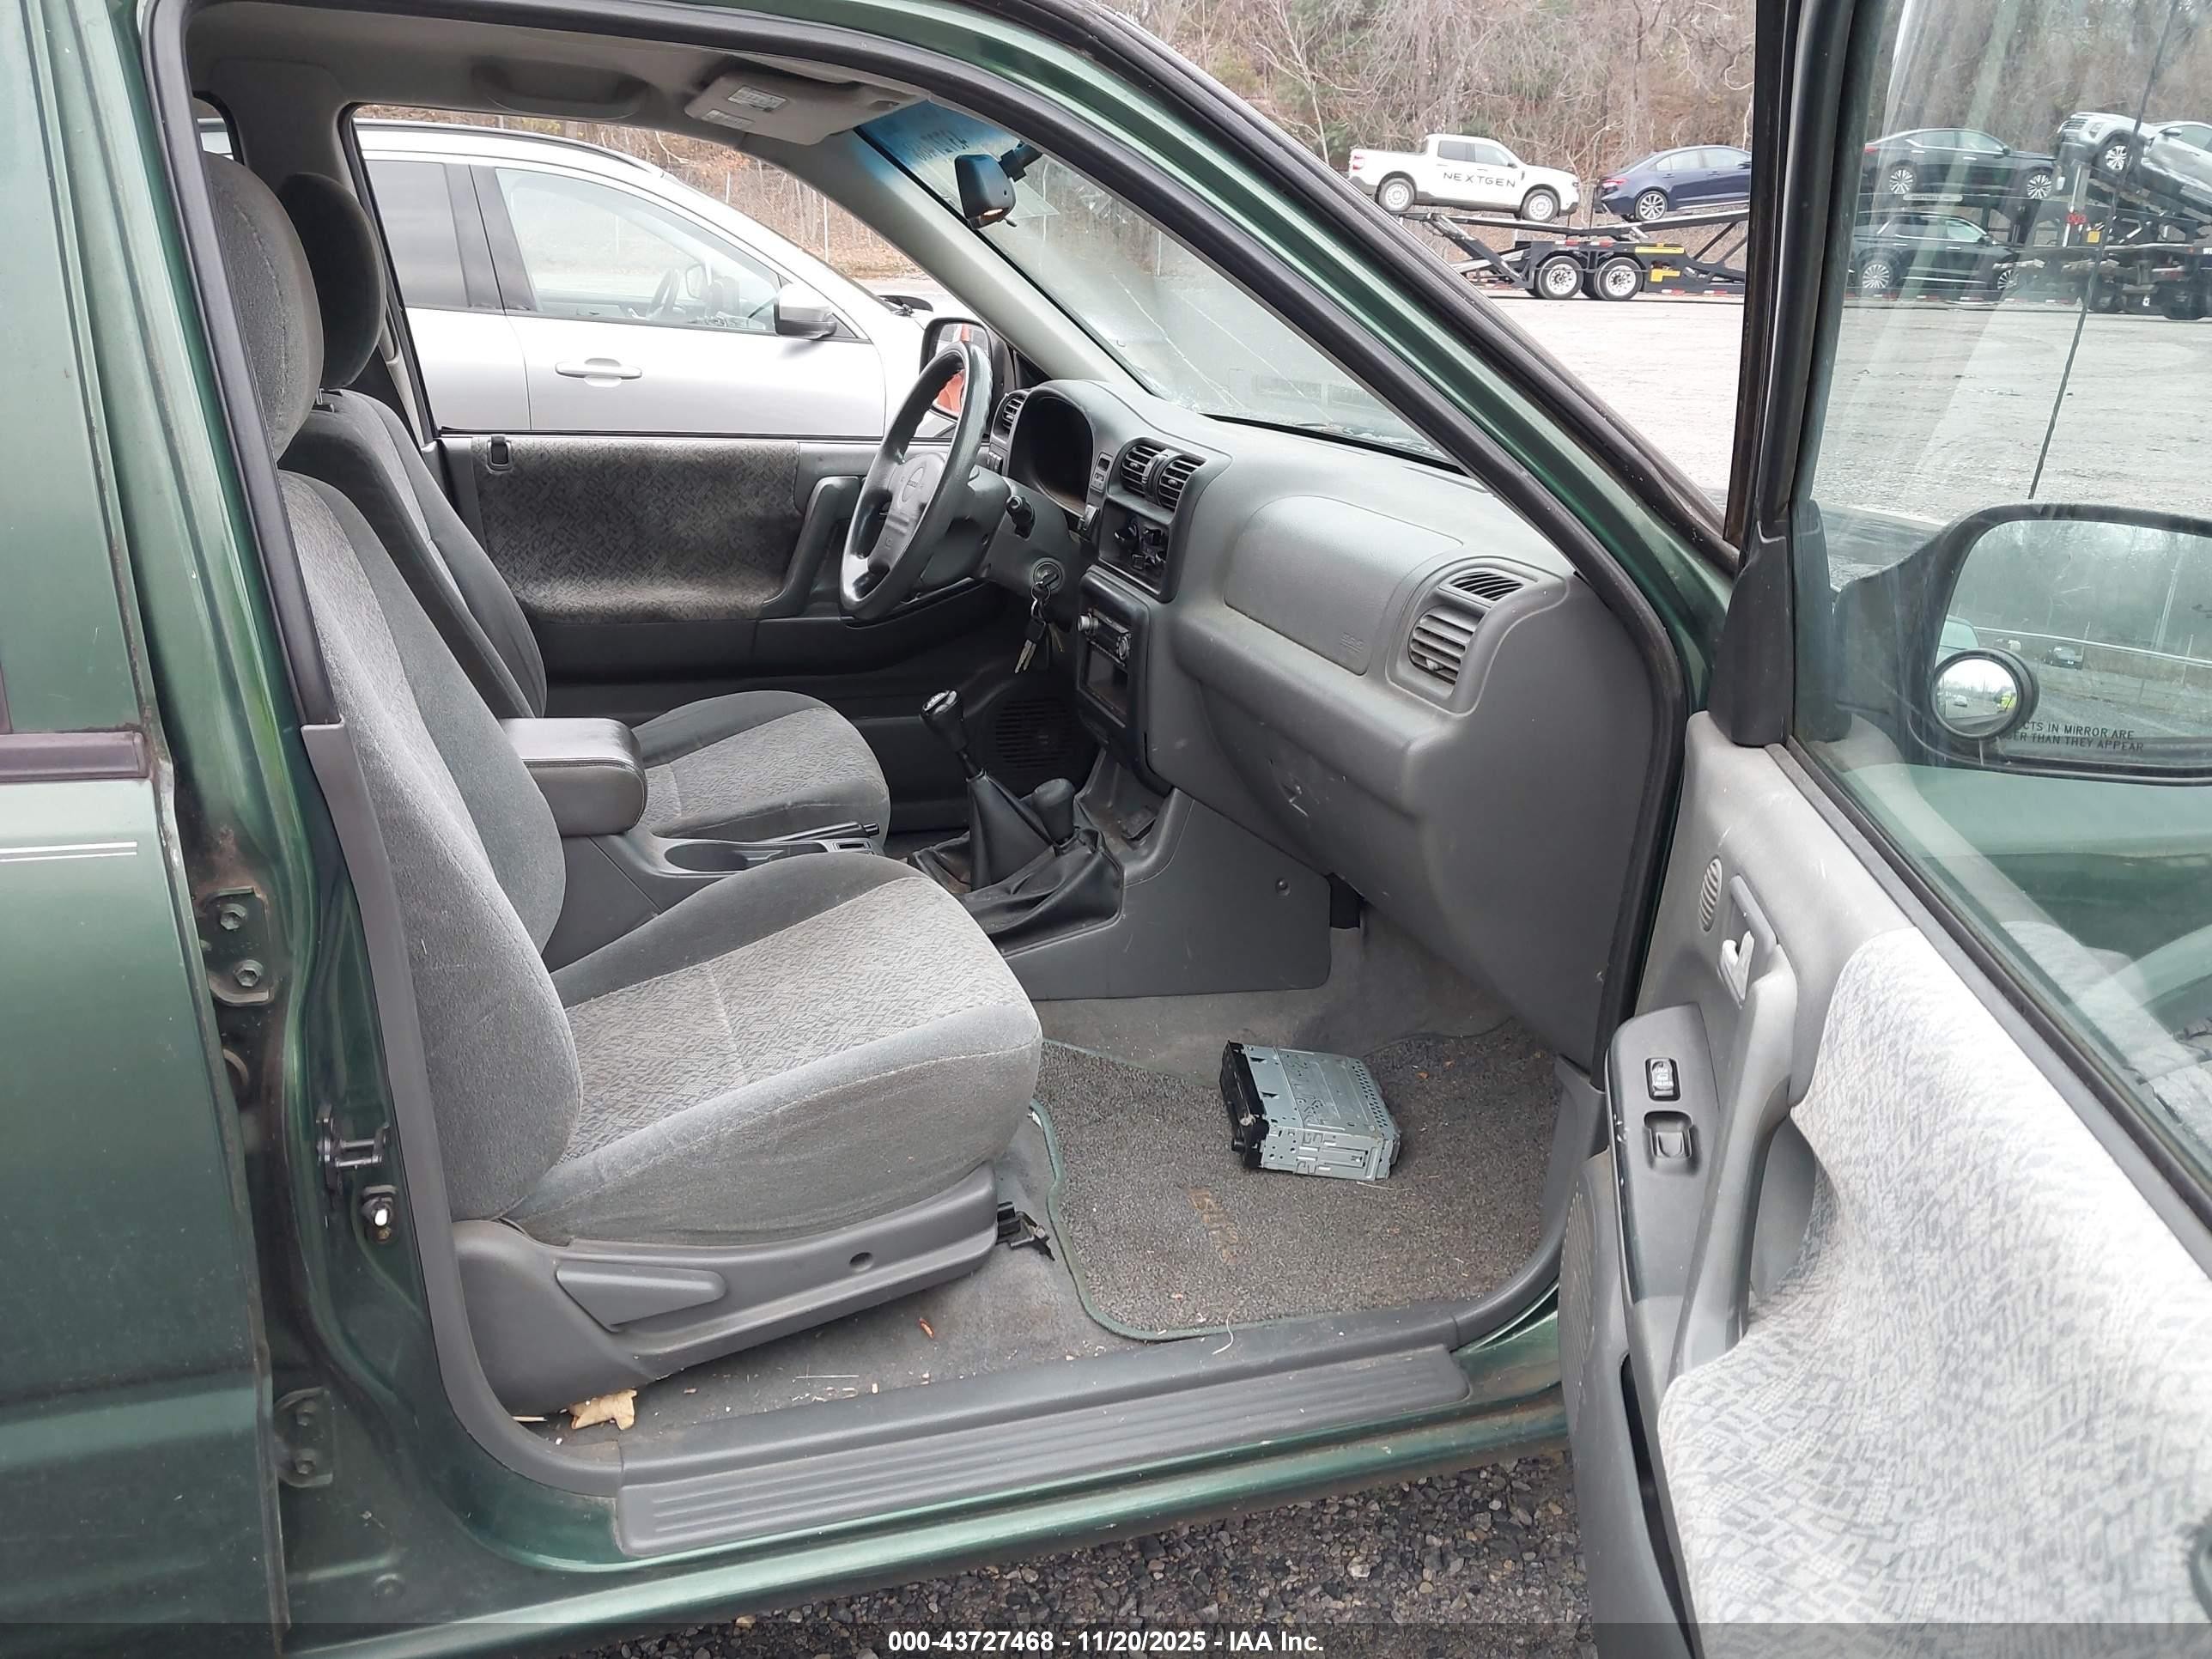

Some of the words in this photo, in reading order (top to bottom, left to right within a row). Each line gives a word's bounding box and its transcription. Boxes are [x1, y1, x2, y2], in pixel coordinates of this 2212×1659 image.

[1443, 172, 1516, 187] NEXTGEN
[2047, 723, 2059, 733] IN
[2063, 724, 2108, 738] MIRROR
[2112, 729, 2135, 740] ARE
[2032, 733, 2061, 744] THAN
[2064, 736, 2094, 747] THEY
[2097, 739, 2144, 752] APPEAR
